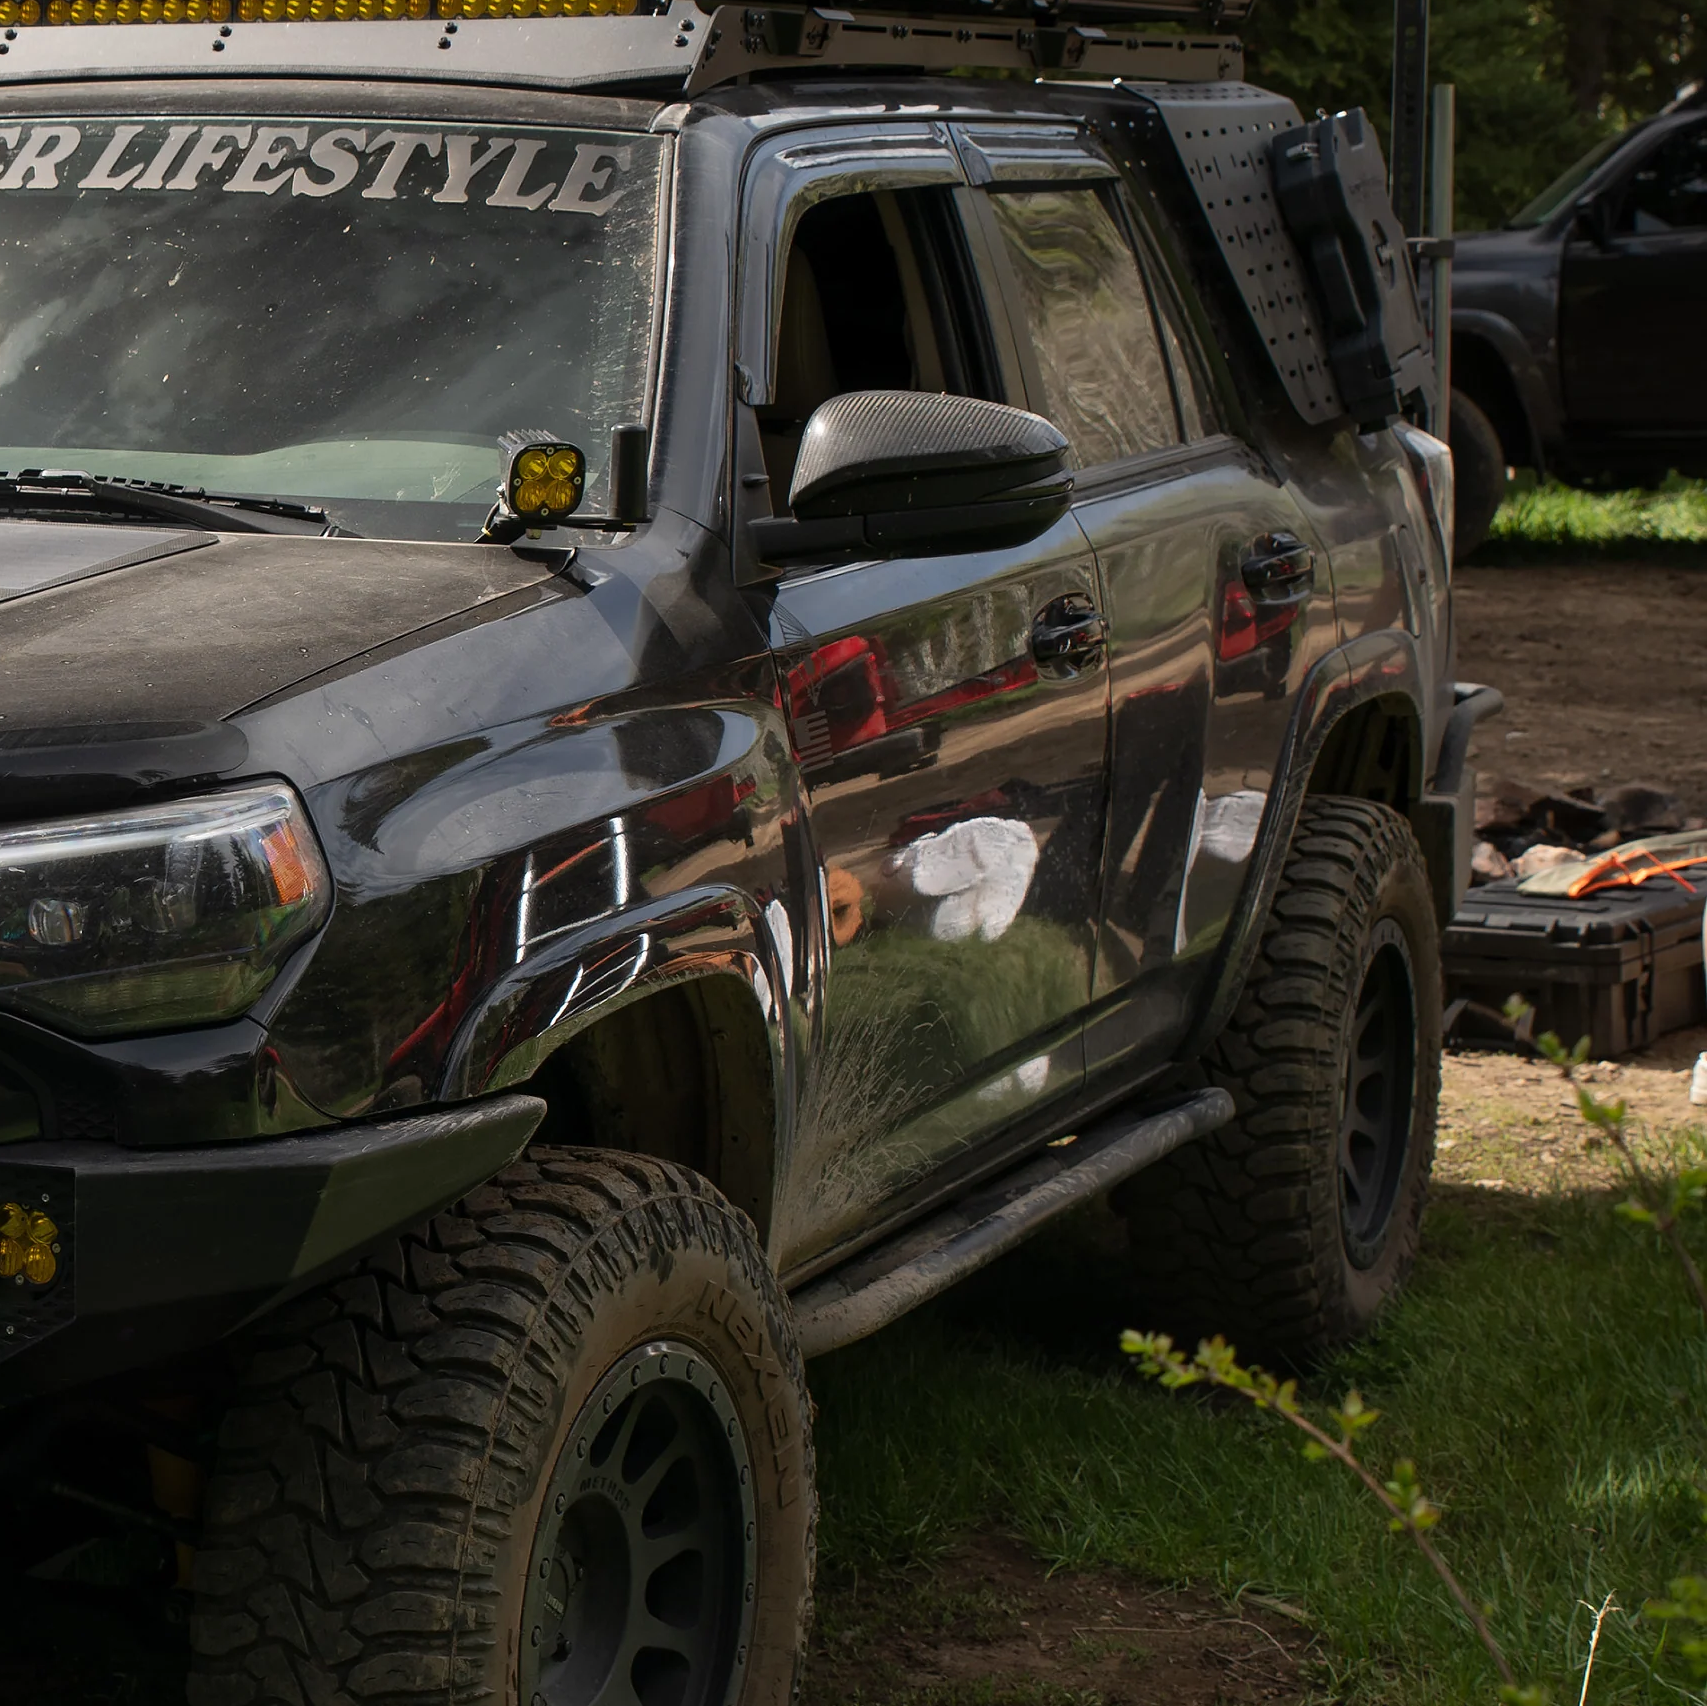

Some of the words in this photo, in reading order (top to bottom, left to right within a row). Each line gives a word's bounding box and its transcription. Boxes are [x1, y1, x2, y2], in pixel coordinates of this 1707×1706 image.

[77, 124, 632, 217] LIFESTYLE
[695, 1279, 798, 1510] NEXEN
[579, 1475, 630, 1512] METHOD
